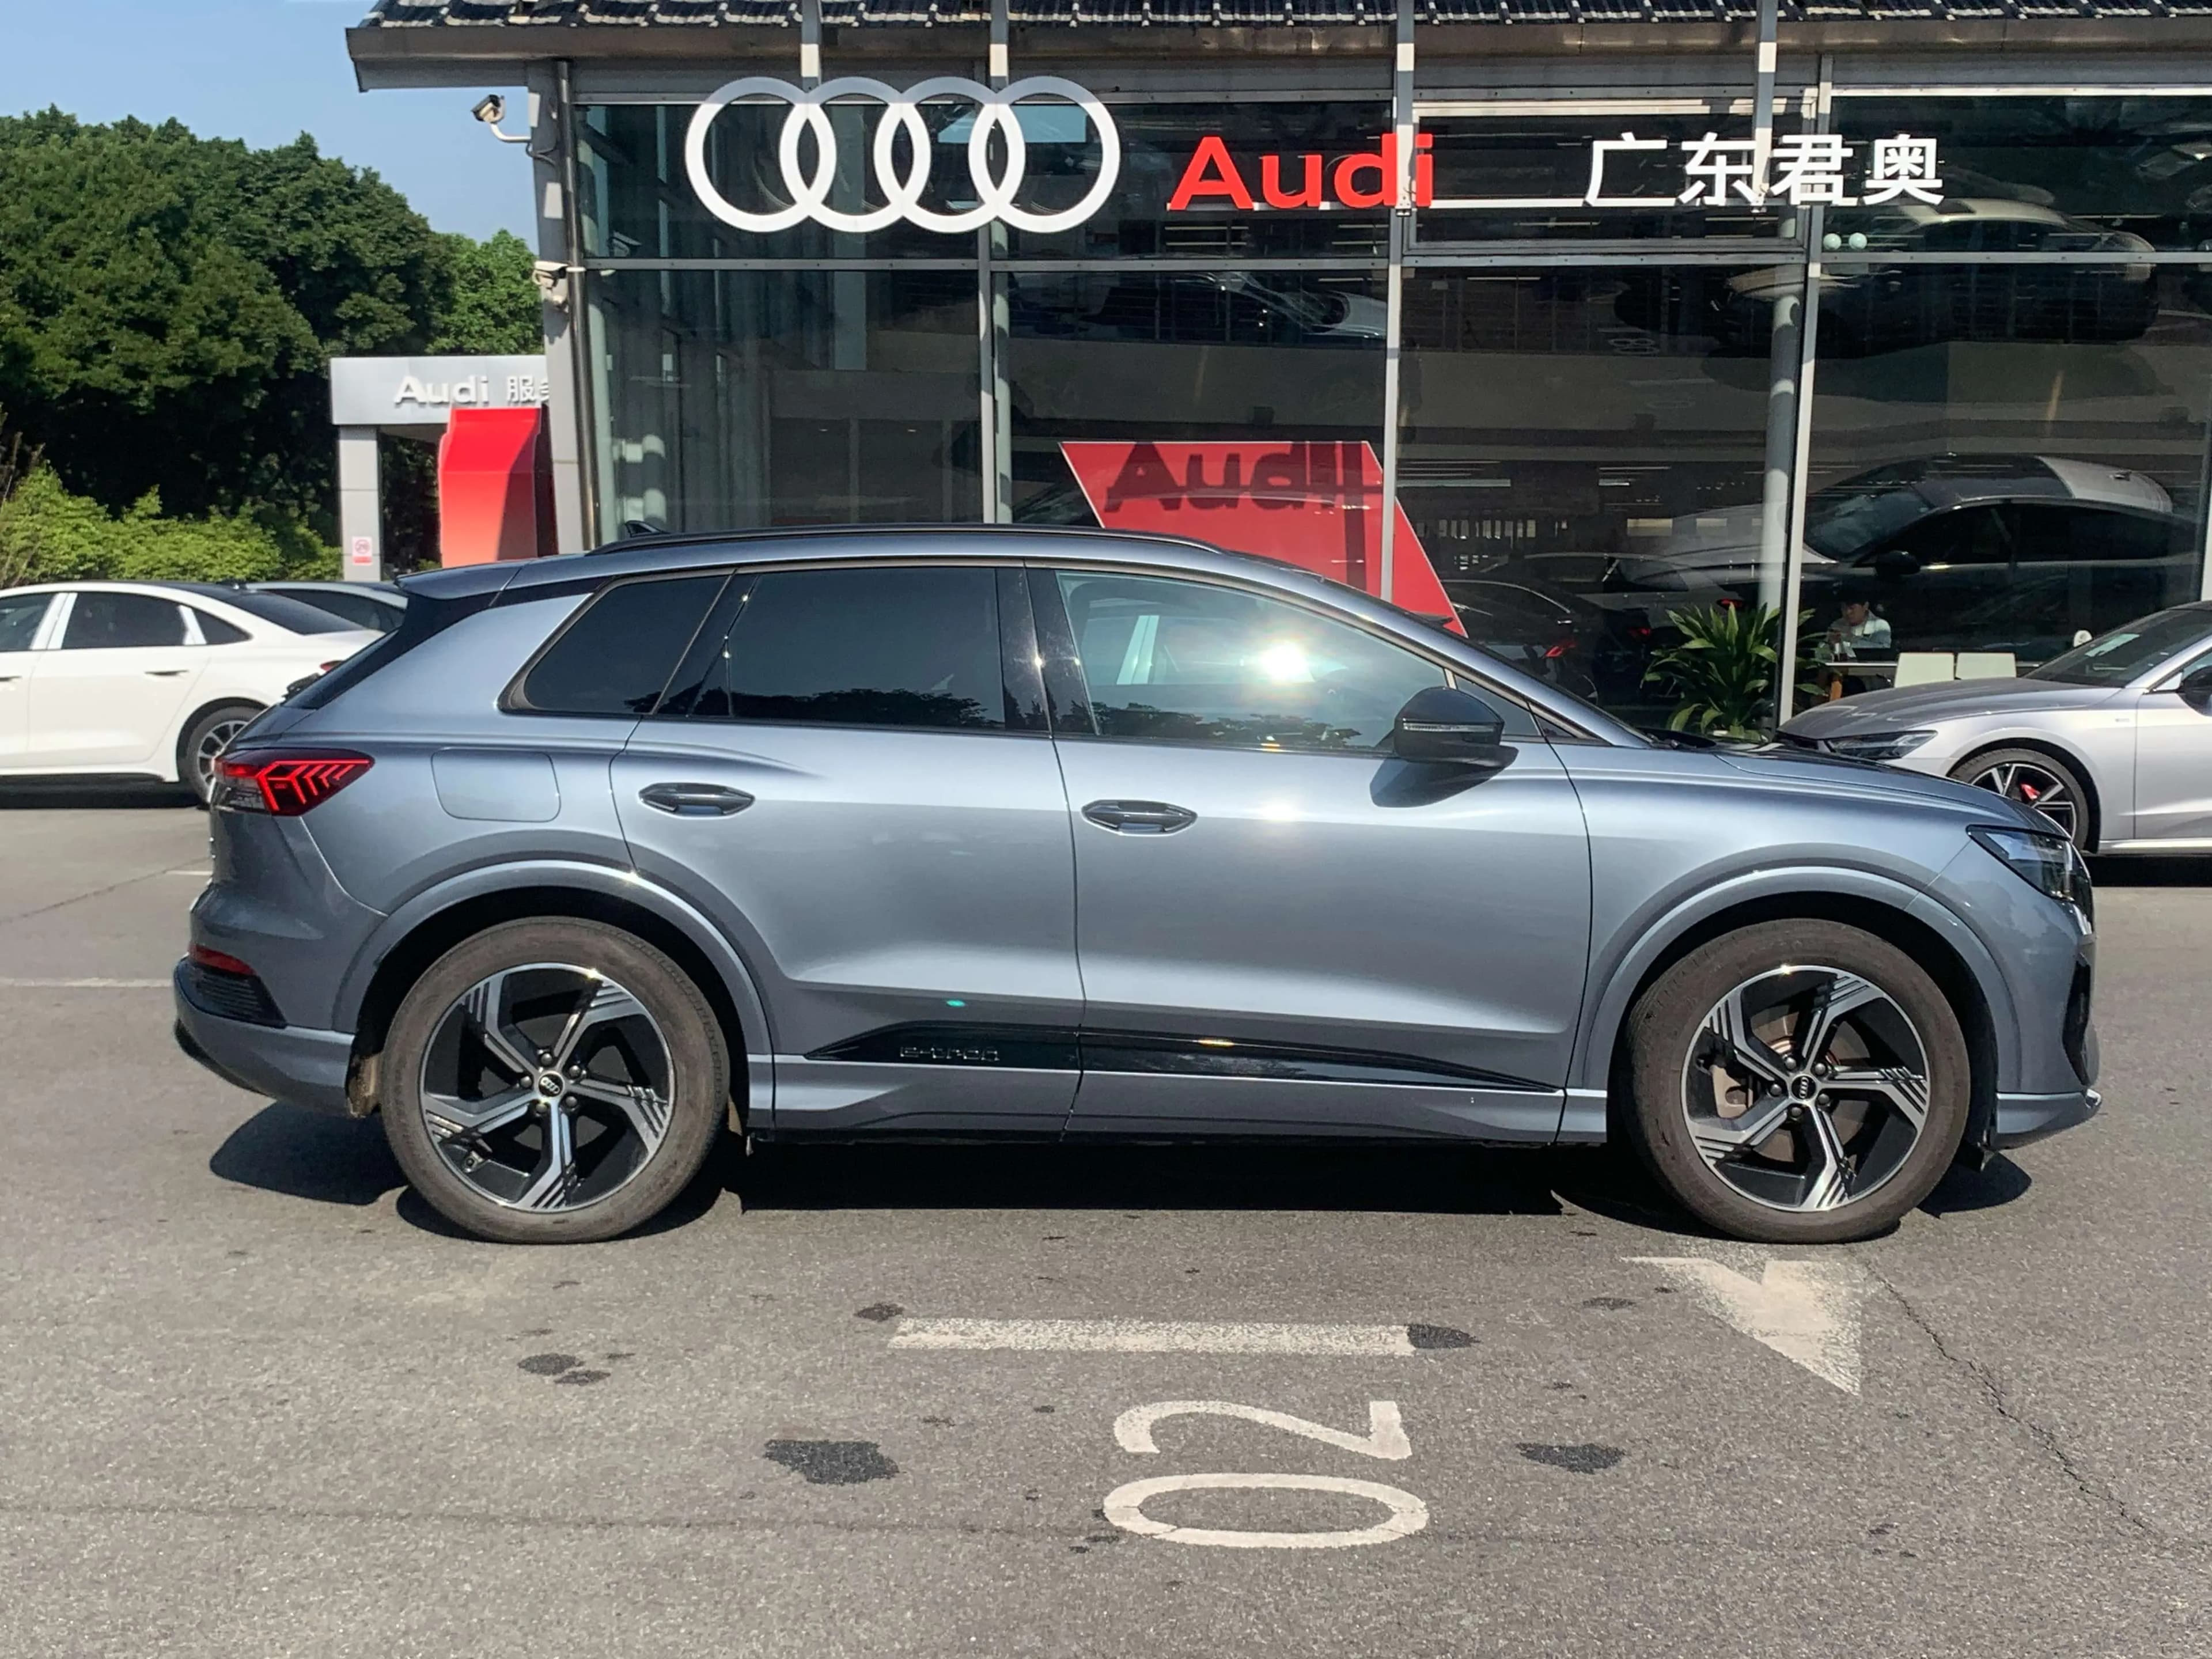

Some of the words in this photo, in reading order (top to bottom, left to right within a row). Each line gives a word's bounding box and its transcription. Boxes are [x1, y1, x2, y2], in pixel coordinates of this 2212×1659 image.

[1168, 133, 1433, 210] Audi
[1583, 131, 1944, 206] 广东君奥
[393, 374, 488, 404] Audi
